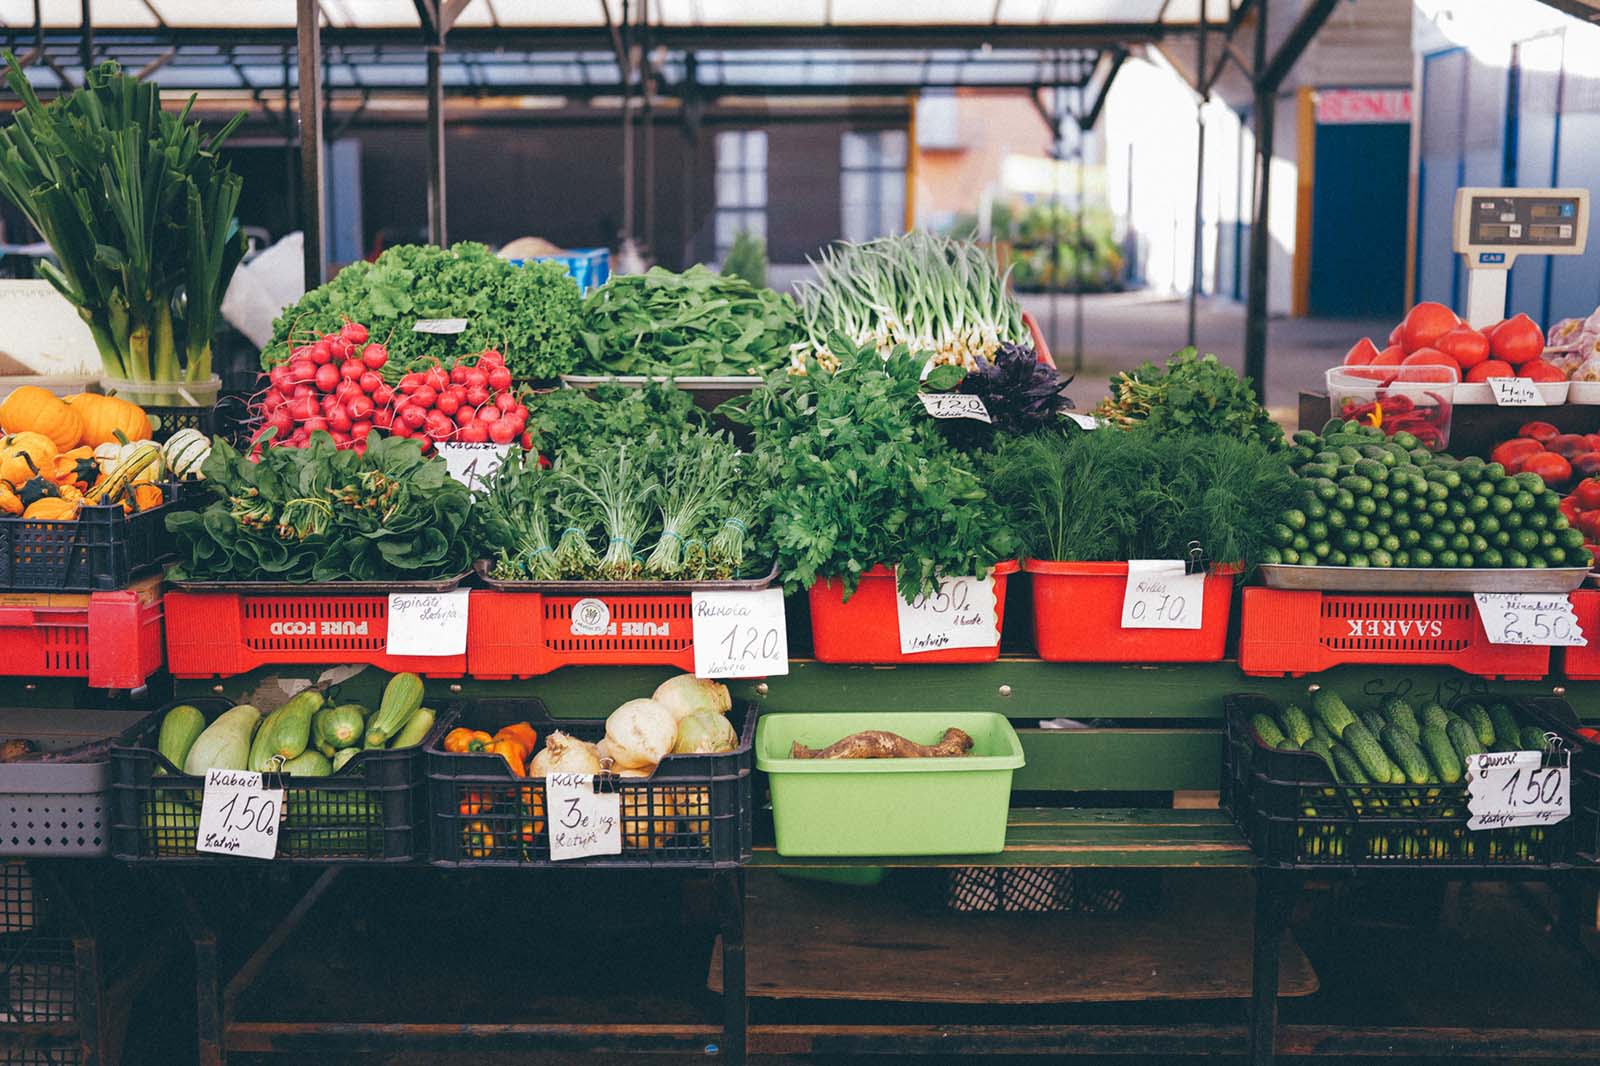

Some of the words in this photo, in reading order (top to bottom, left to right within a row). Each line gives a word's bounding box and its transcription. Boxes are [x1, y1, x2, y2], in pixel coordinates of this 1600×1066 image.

[270, 621, 317, 635] FOOD
[321, 621, 369, 635] PURE
[621, 622, 670, 636] PURE
[1347, 620, 1442, 636] SAAREK
